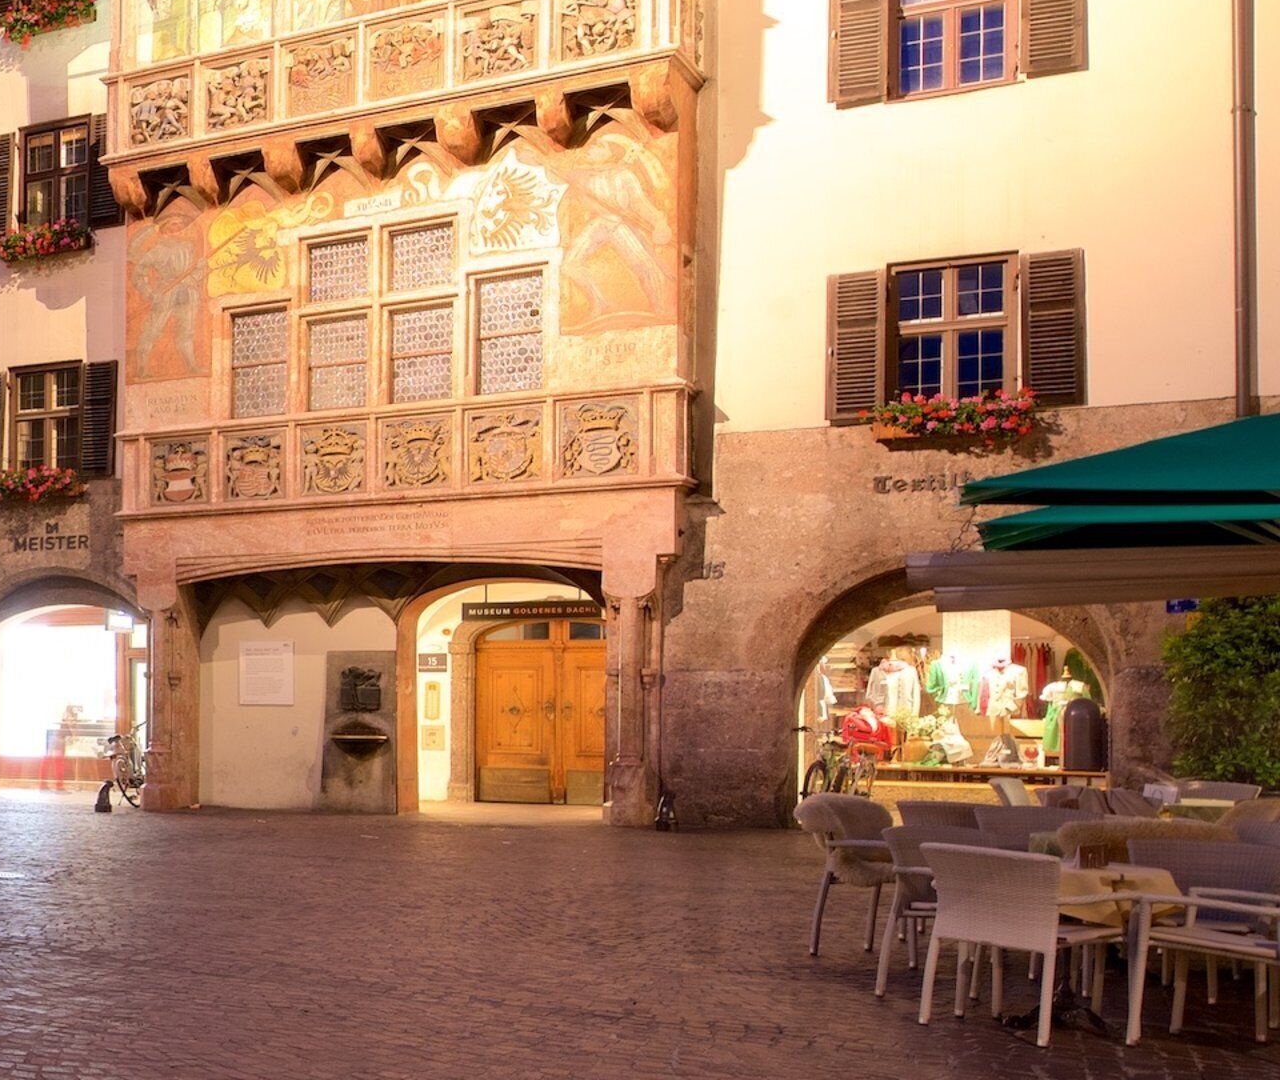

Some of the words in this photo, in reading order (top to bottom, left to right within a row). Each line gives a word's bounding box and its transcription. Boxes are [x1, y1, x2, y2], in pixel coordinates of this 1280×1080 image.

[12, 535, 90, 552] MEISTER
[468, 608, 511, 616] MUSEUM
[513, 607, 563, 615] GOLDENES
[566, 606, 597, 614] DACHL
[427, 656, 438, 666] 15
